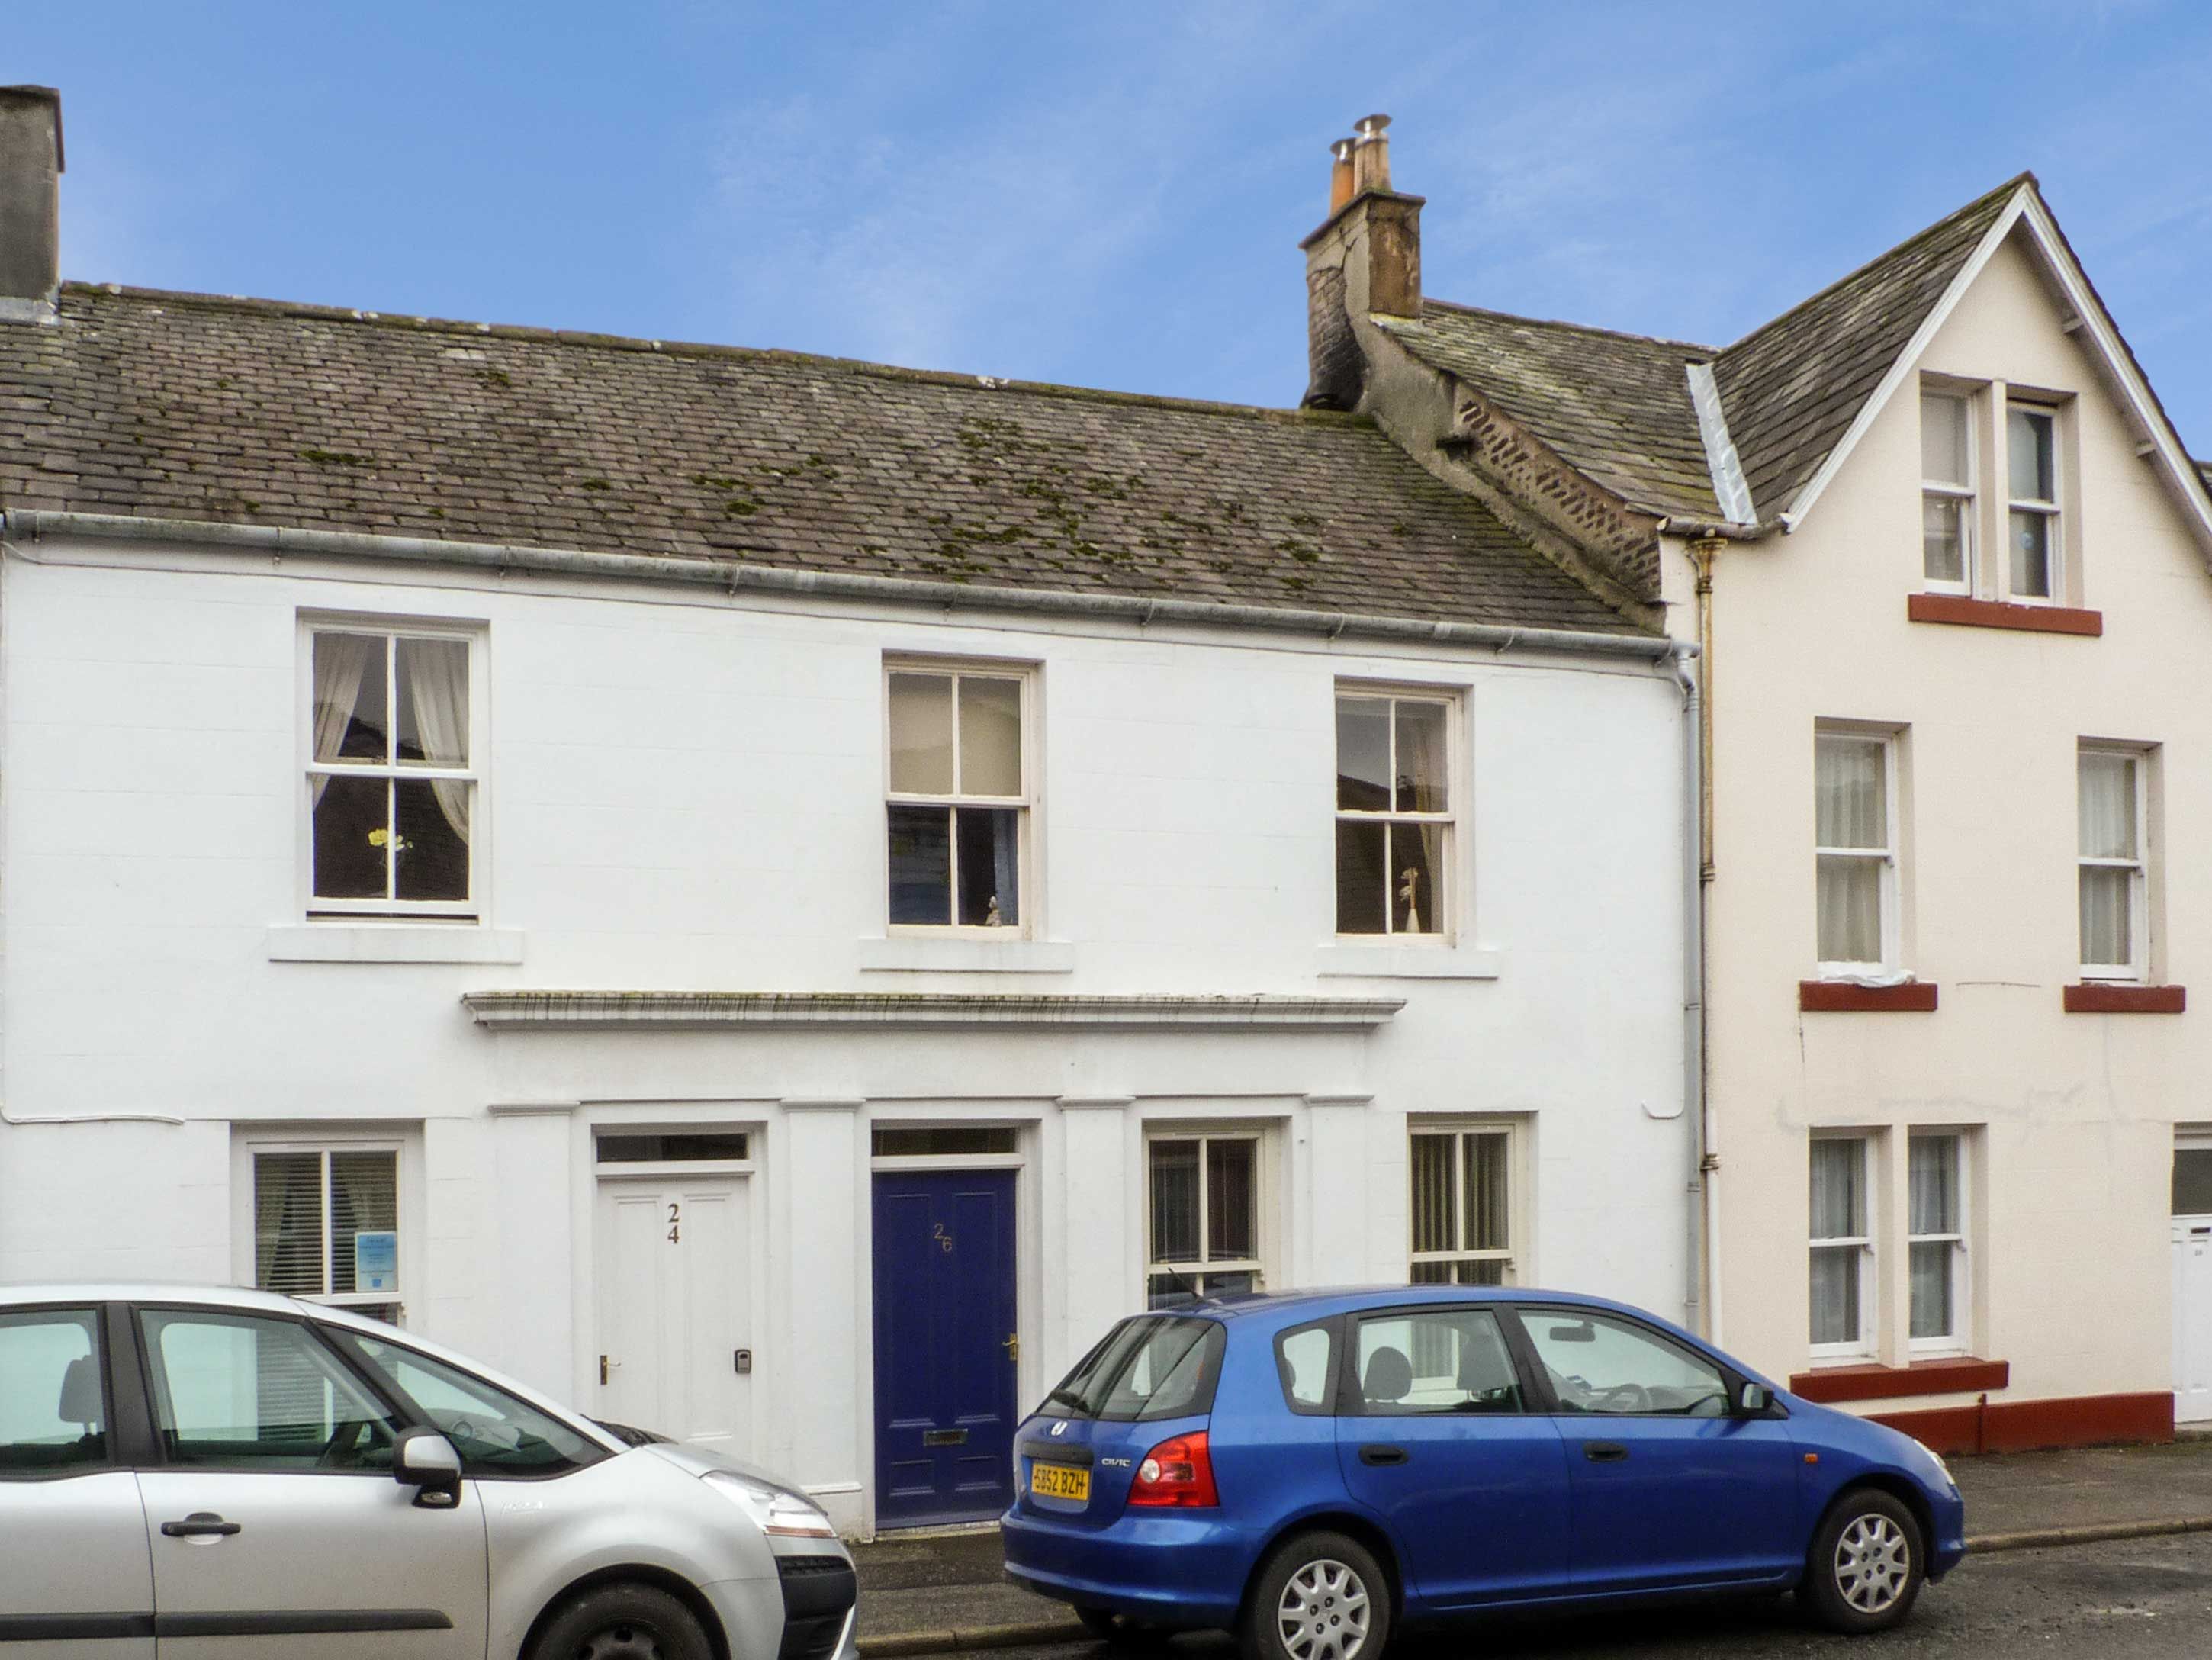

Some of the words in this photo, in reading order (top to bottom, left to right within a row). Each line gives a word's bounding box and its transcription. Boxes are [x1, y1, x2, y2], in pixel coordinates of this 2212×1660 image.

[667, 1203, 680, 1244] 24
[934, 1223, 953, 1252] 26
[1101, 1457, 1131, 1468] CIVIC
[1061, 1471, 1085, 1495] BZH
